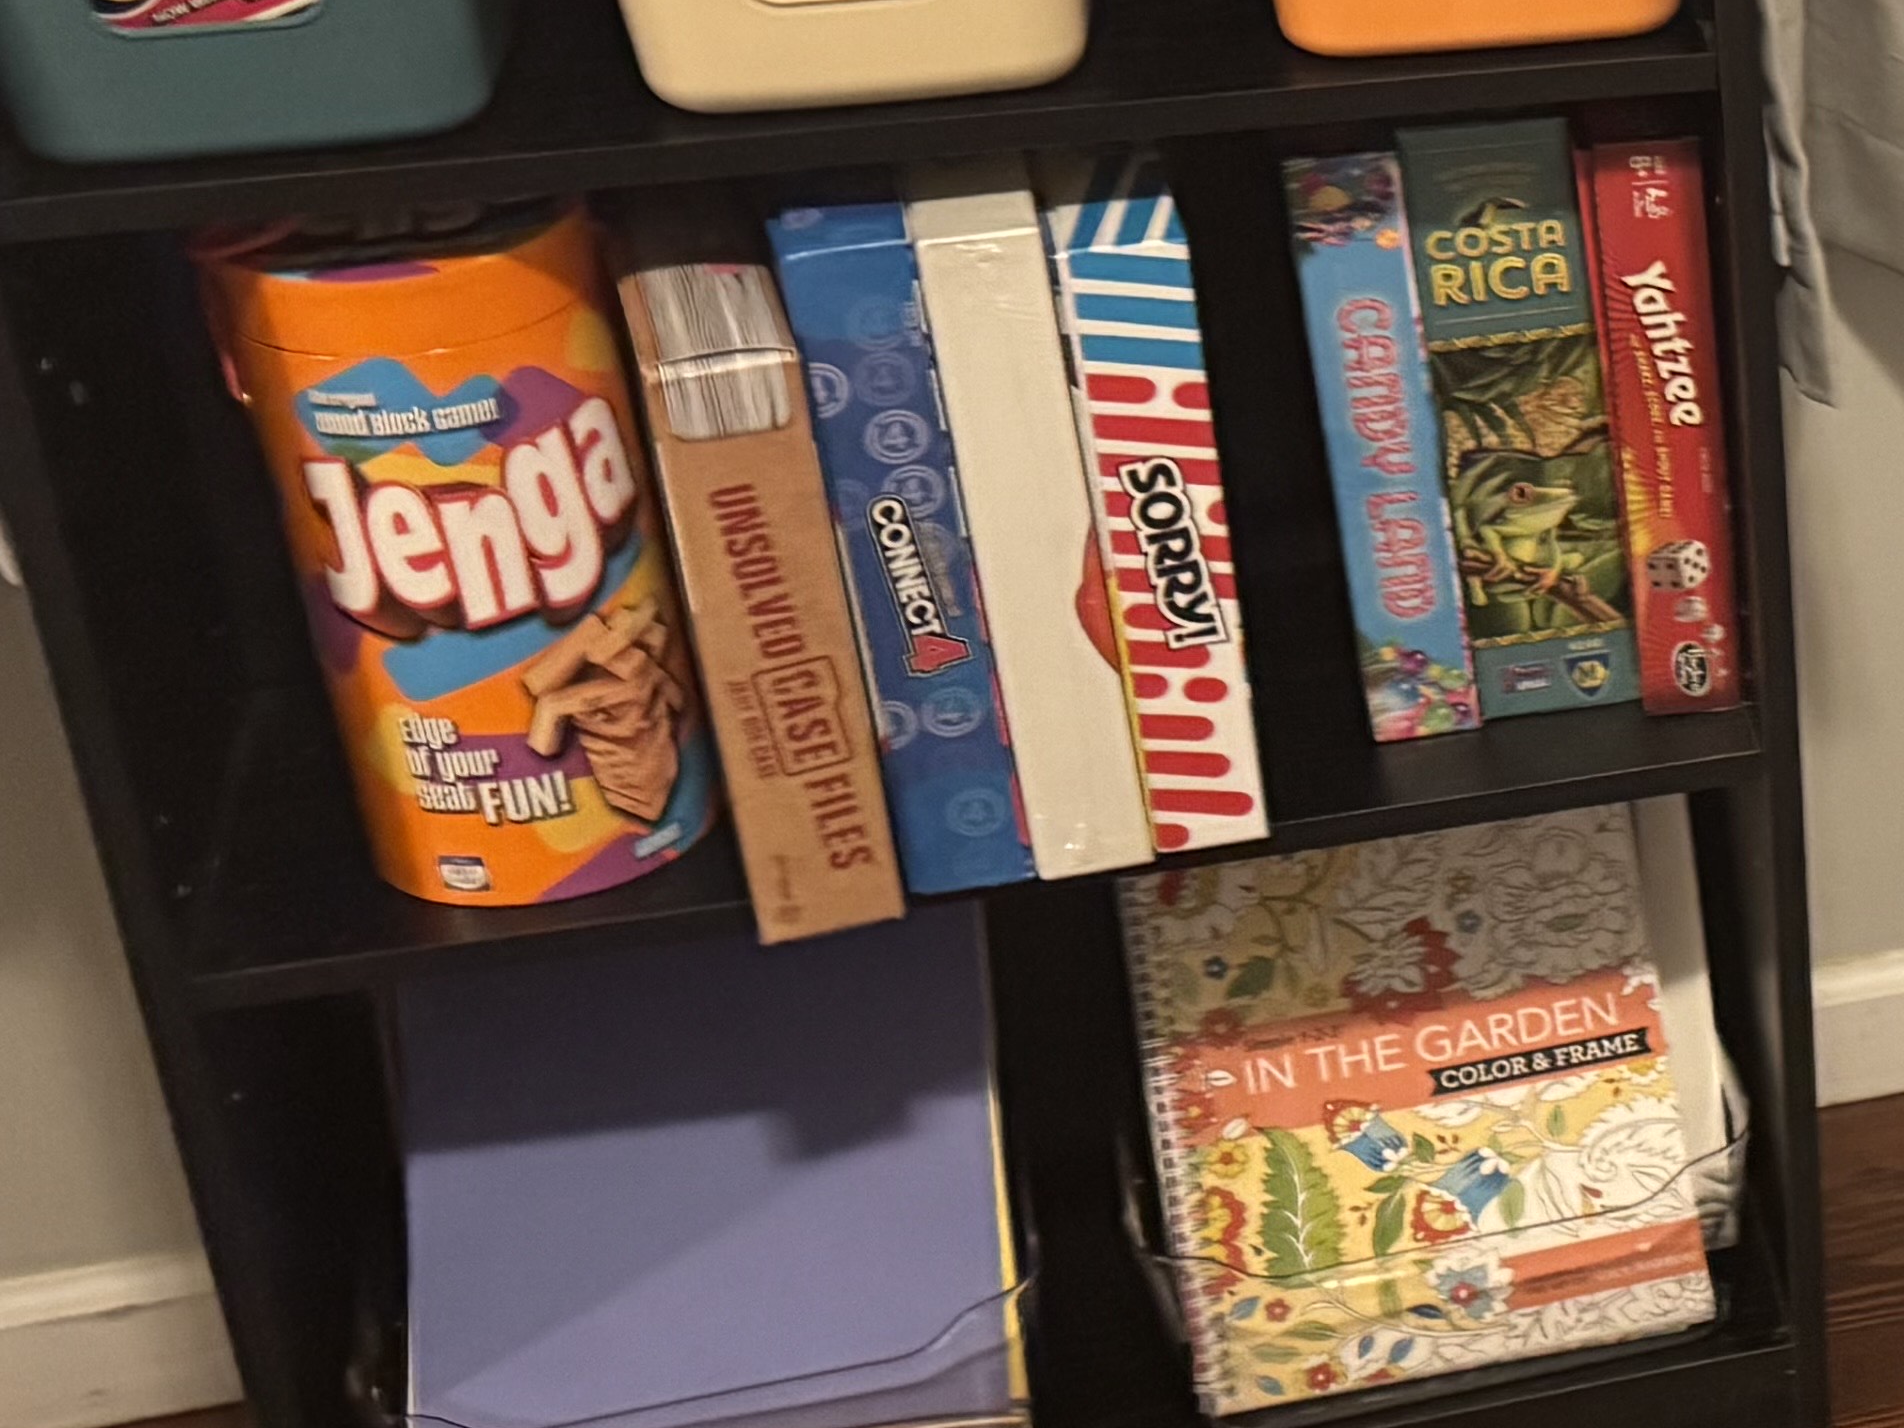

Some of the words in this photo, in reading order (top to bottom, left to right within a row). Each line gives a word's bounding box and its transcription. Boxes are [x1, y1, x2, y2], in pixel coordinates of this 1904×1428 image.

[1425, 219, 1567, 260] COSTA
[1430, 252, 1572, 306] RICA
[1337, 297, 1418, 475] CANDY
[1619, 259, 1705, 427] Yahtzee
[303, 396, 637, 626] Jenga
[1123, 460, 1222, 645] SORRY!
[1365, 490, 1437, 618] LAND
[709, 483, 806, 659] UNSOLVED
[869, 498, 942, 639] CONNECT
[905, 634, 970, 673] 4
[400, 713, 458, 749] Edge
[772, 669, 841, 764] CASE
[404, 746, 434, 777] of
[436, 749, 499, 783] your
[418, 781, 477, 811] seat
[478, 771, 573, 824] FUN!
[805, 774, 875, 869] FILES
[1245, 1056, 1298, 1096] IN
[1305, 1034, 1410, 1083] THE
[1414, 991, 1623, 1063] GARDEN
[1440, 1055, 1528, 1090] COLOR
[1531, 1050, 1554, 1071] &
[1555, 1033, 1642, 1068] FRAME
